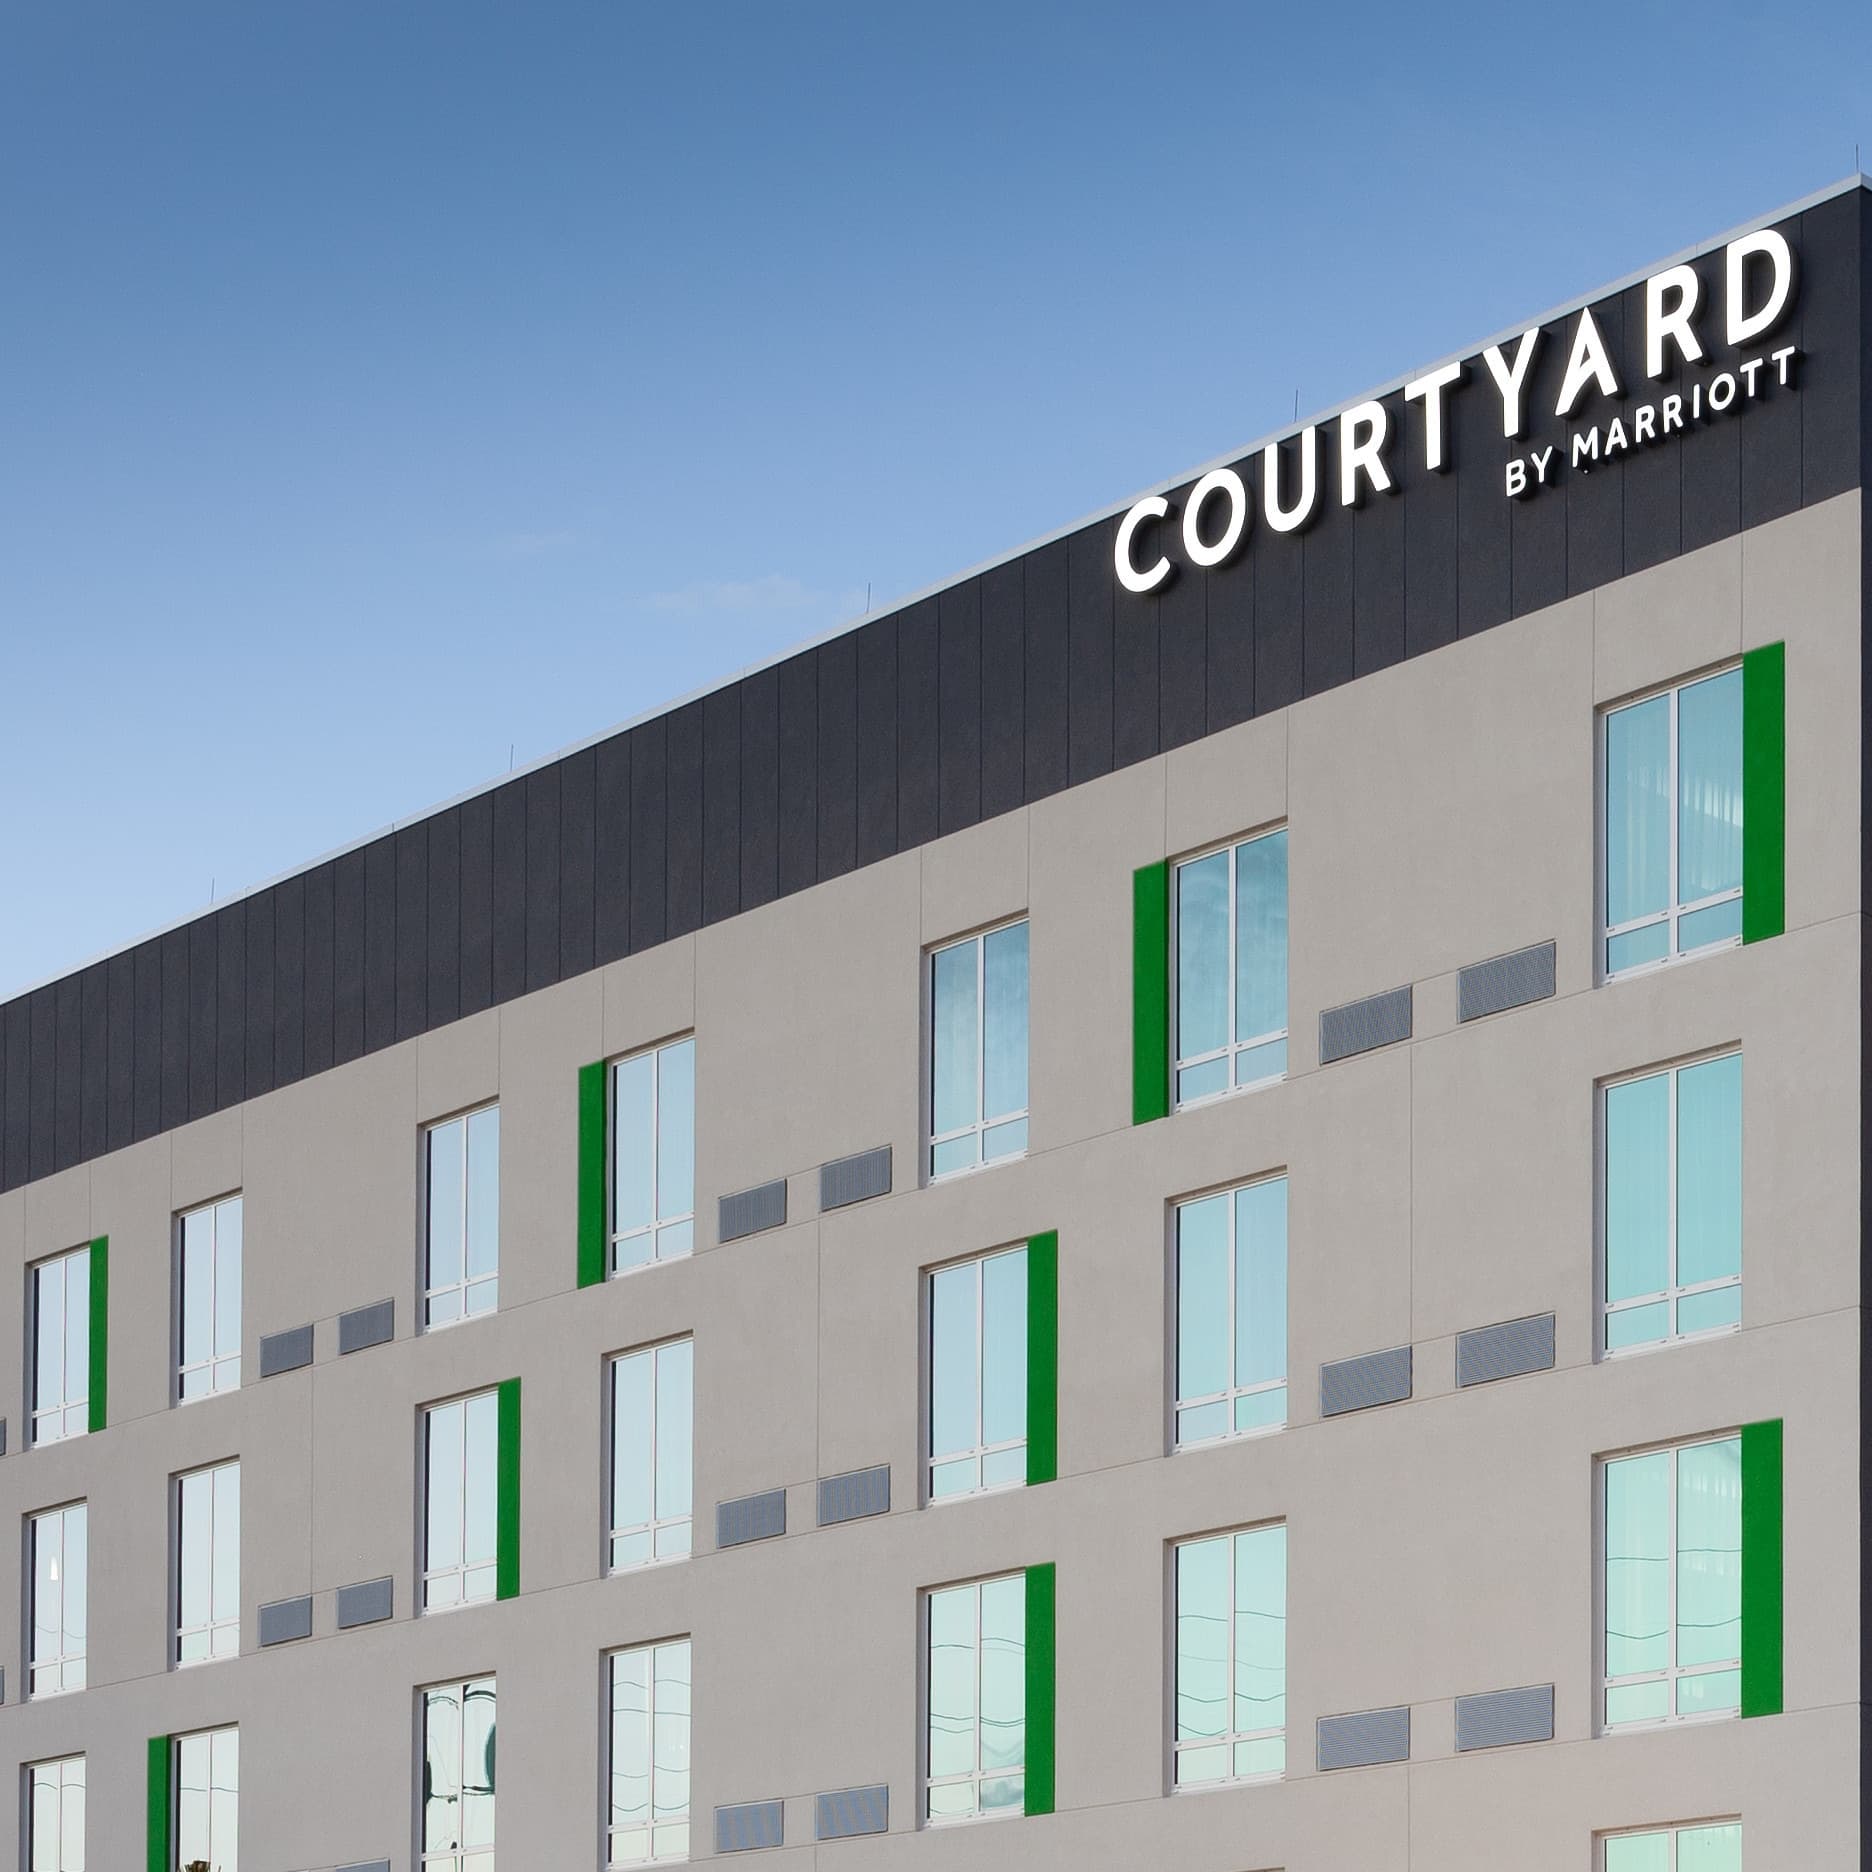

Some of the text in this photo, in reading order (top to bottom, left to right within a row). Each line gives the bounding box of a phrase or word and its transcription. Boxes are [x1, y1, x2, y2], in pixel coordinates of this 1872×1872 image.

[1114, 229, 1792, 593] COURTYARD
[1506, 346, 1796, 498] BY MARRIOTT
